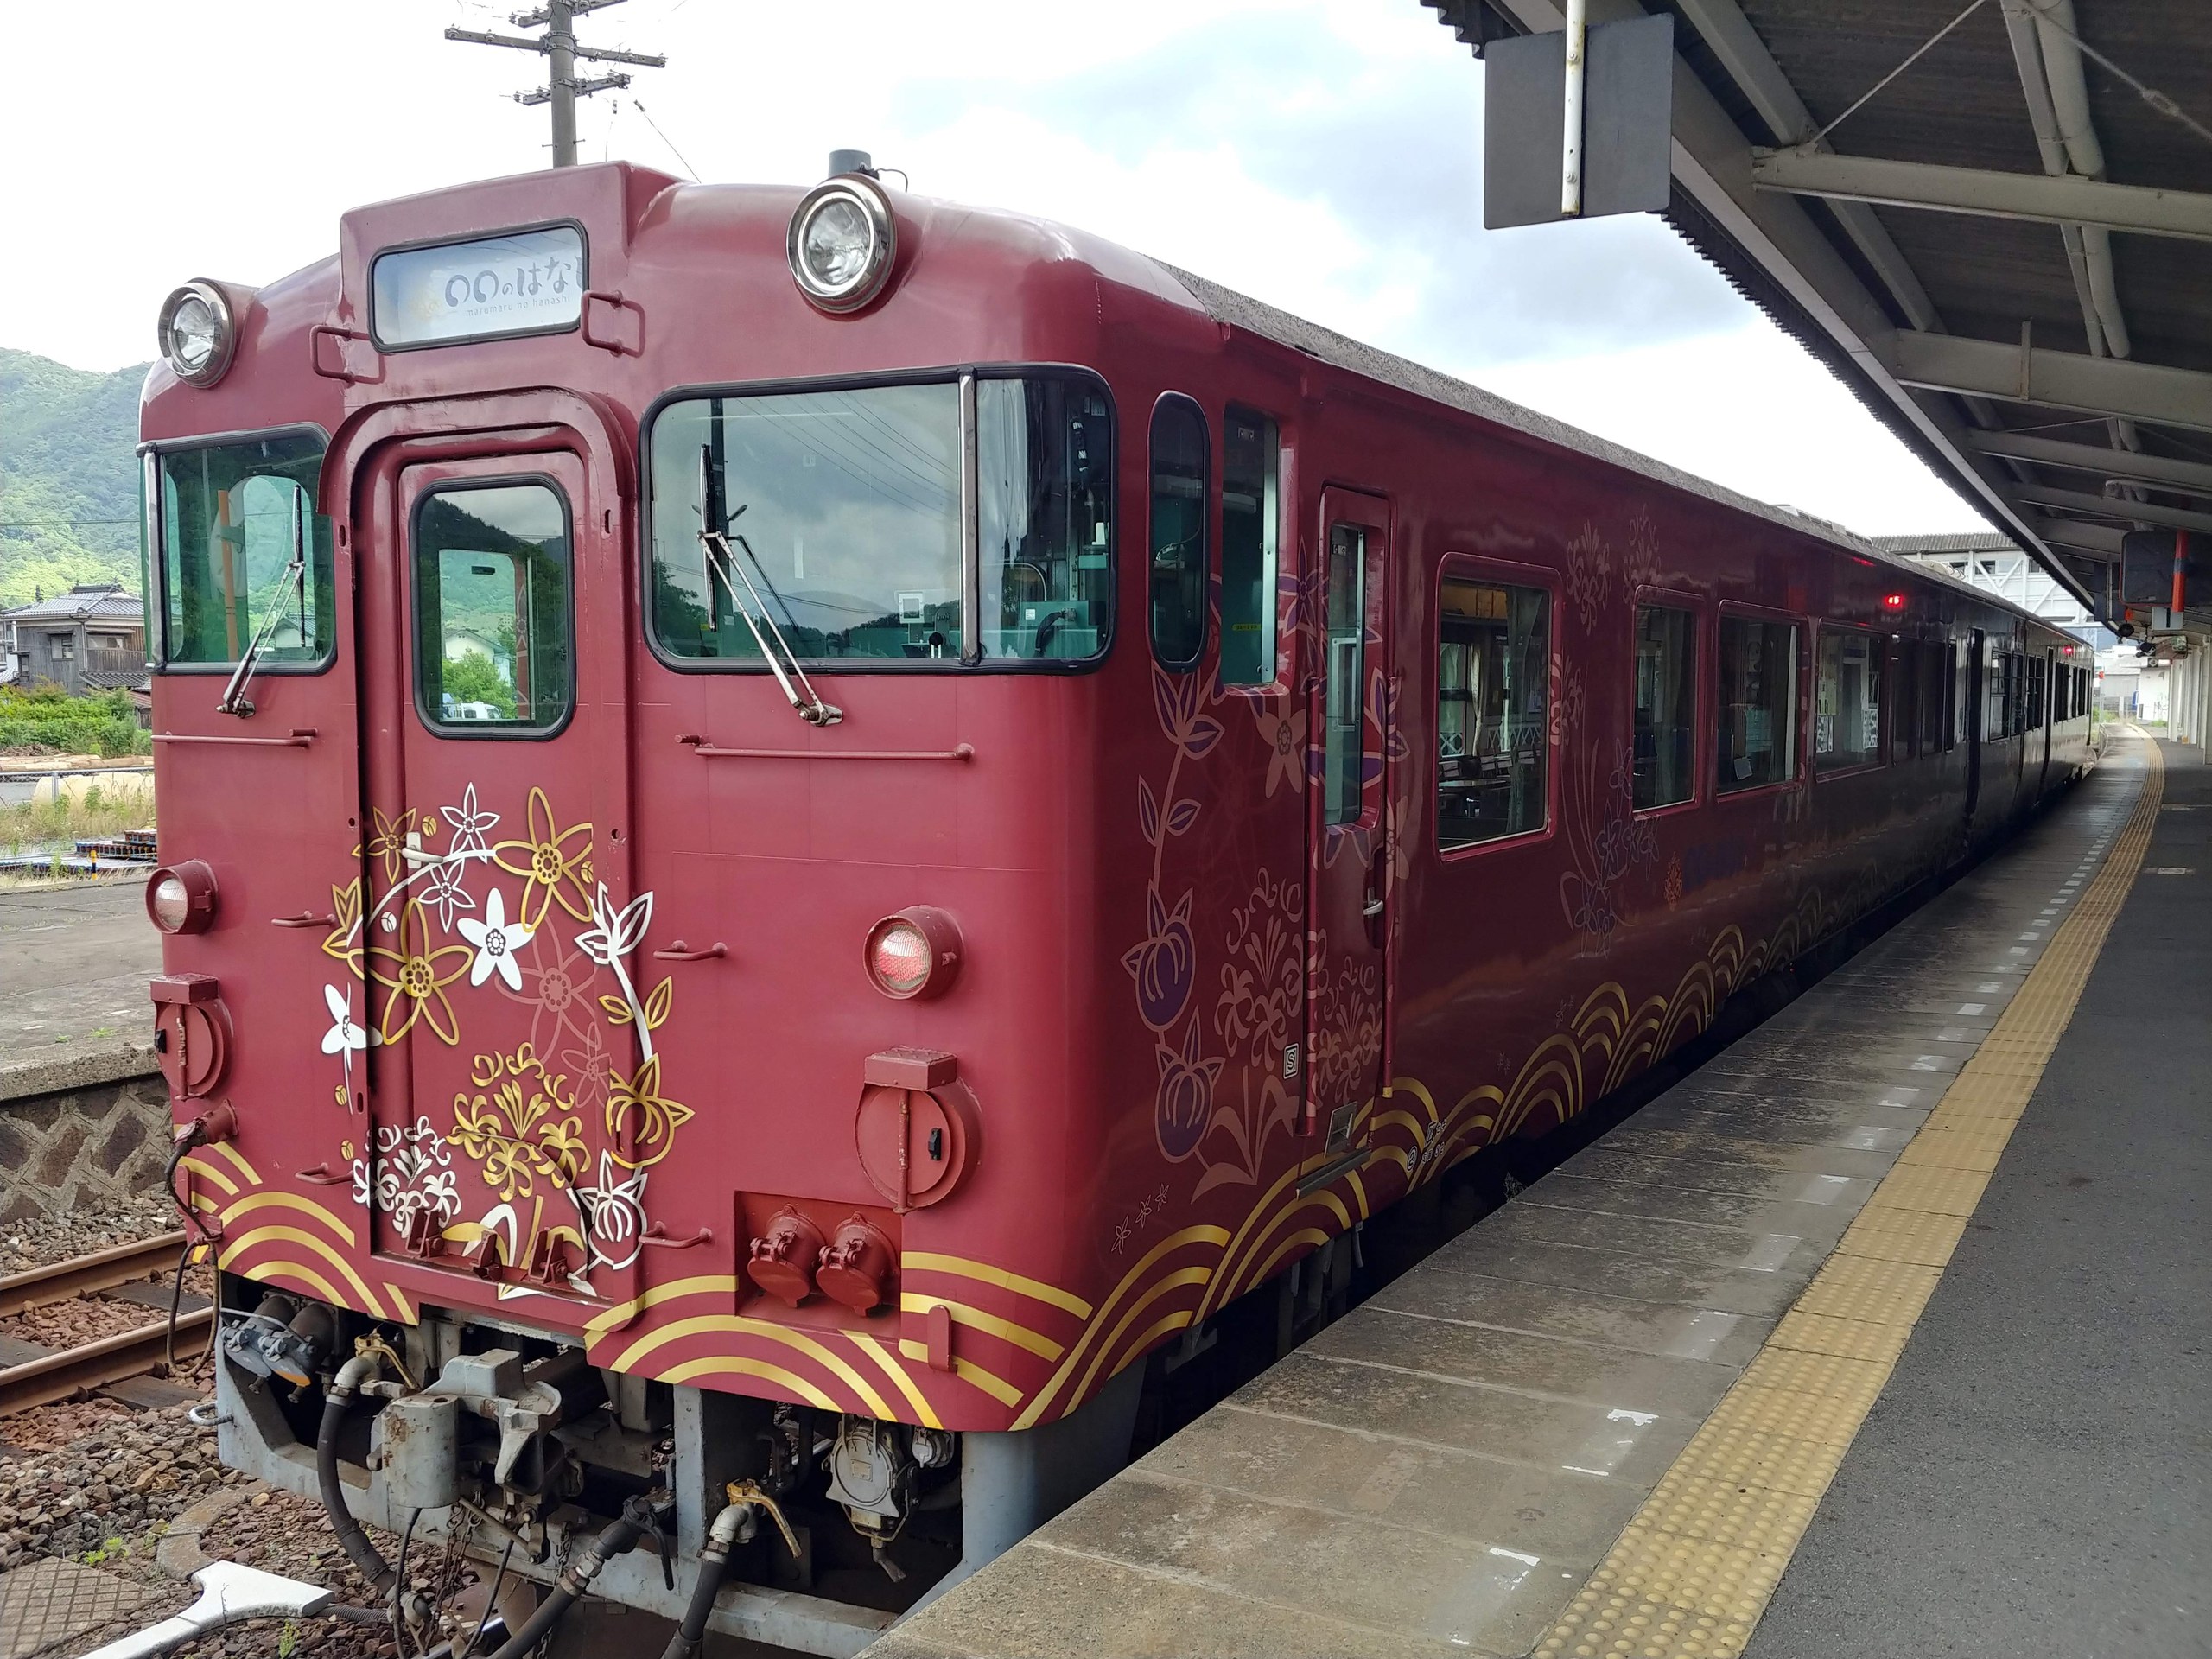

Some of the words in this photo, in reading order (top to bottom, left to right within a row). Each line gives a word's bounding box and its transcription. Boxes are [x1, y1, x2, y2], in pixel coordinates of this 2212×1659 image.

[466, 304, 513, 317] marumaru
[517, 301, 529, 309] no
[533, 295, 570, 307] hanashi
